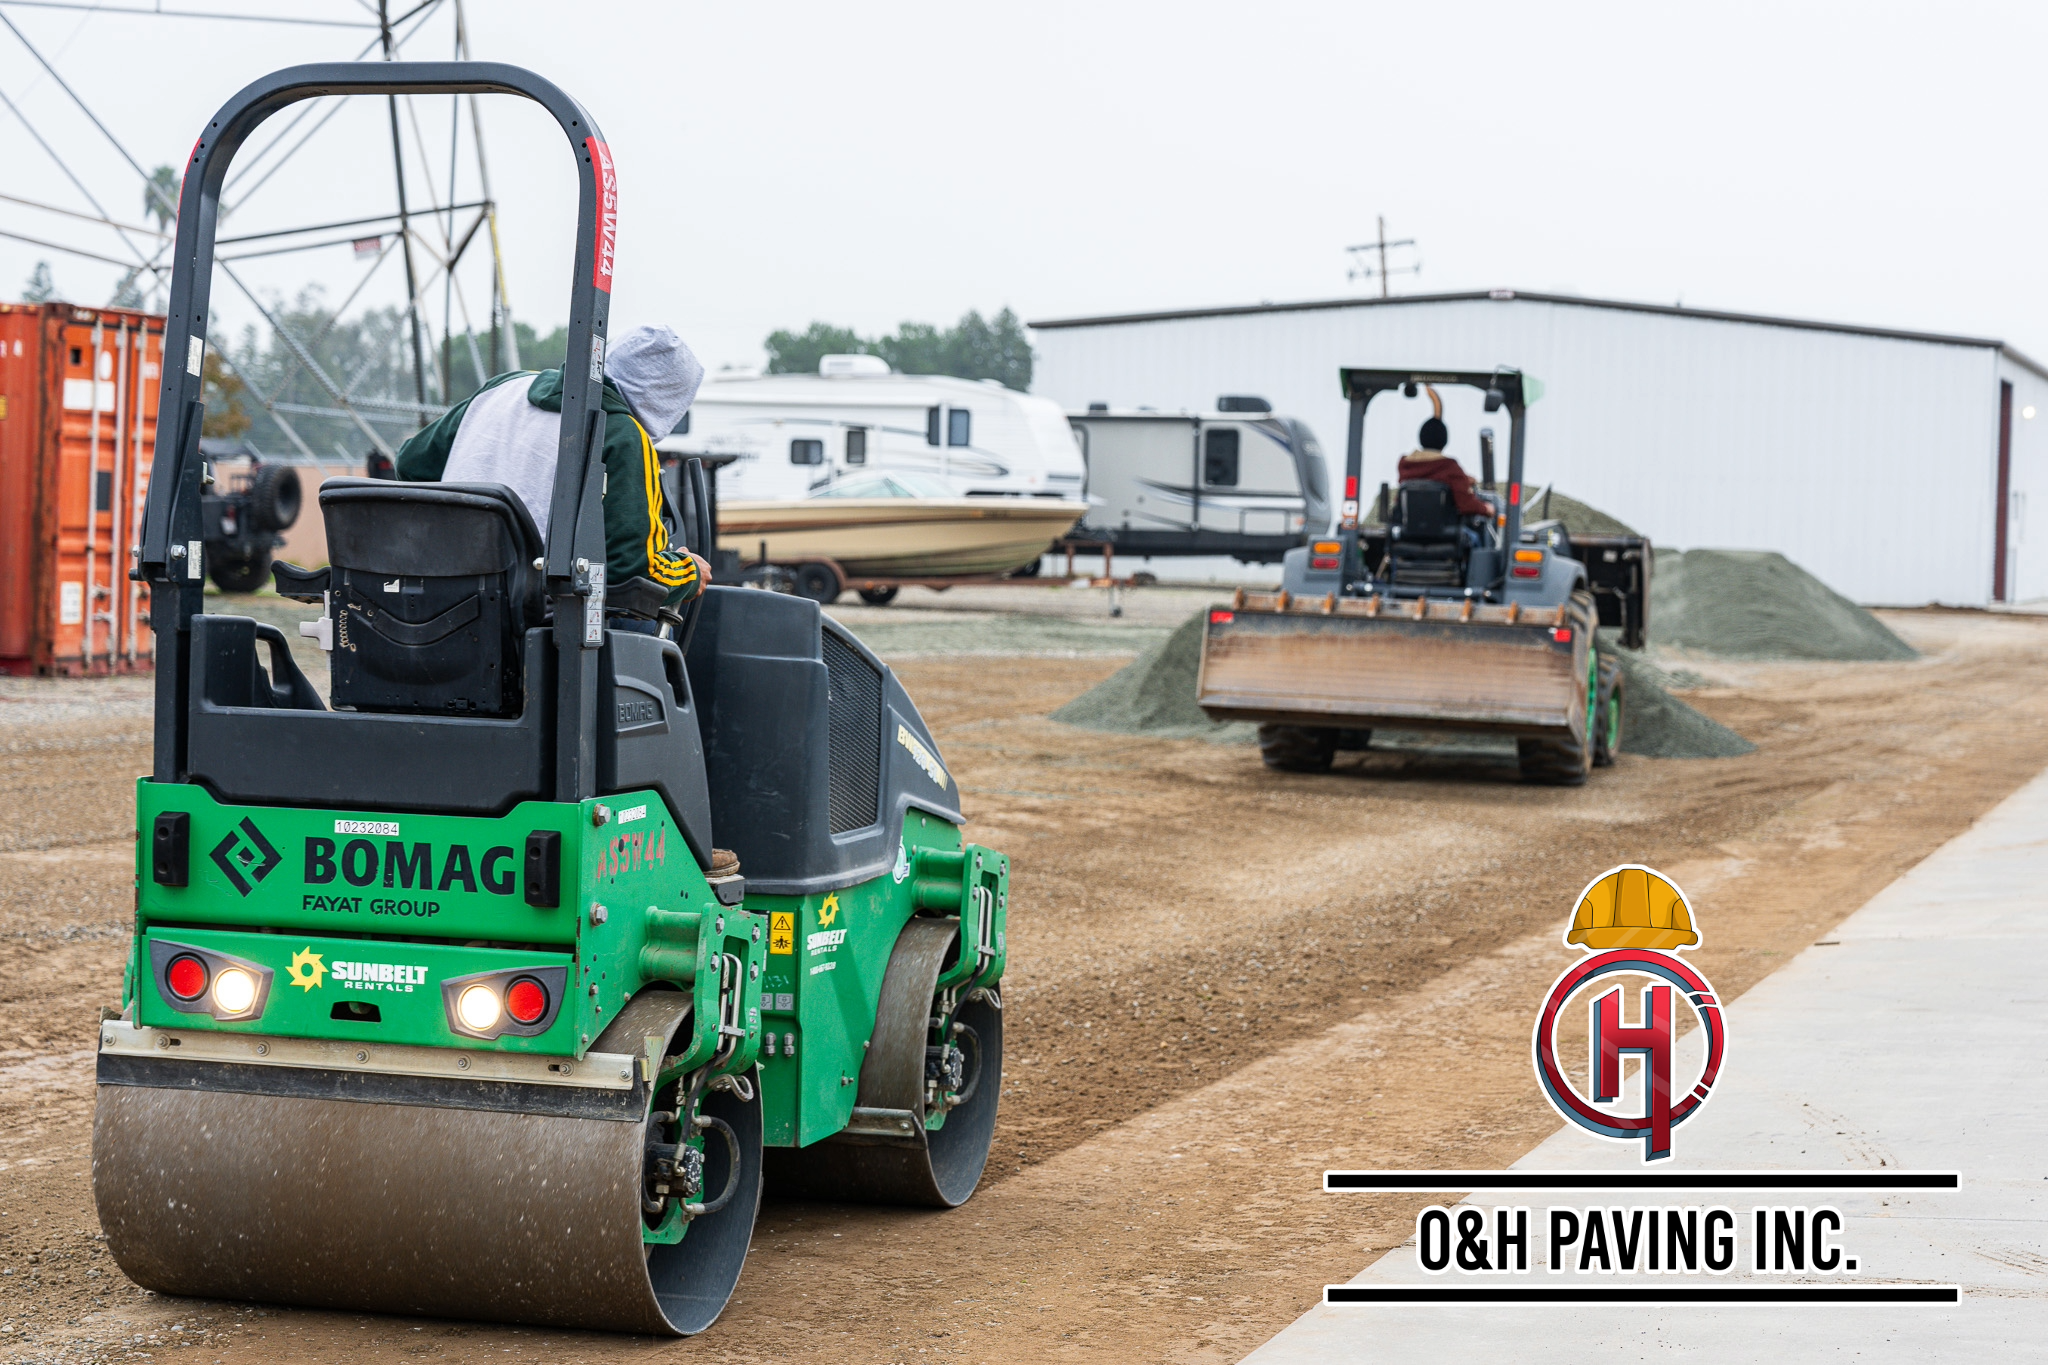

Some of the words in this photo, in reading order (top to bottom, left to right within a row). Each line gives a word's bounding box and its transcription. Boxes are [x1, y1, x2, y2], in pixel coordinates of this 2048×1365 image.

[599, 152, 617, 276] AS5W44
[617, 701, 653, 722] BOMAG
[336, 821, 398, 834] 10232084
[304, 836, 516, 896] BOMAG
[302, 894, 362, 914] FAYAT
[369, 898, 441, 918] GROUP
[806, 928, 848, 951] SUNBELT
[810, 945, 838, 957] RENTALS
[331, 960, 429, 985] SUNBELT
[344, 981, 414, 993] RENTALS
